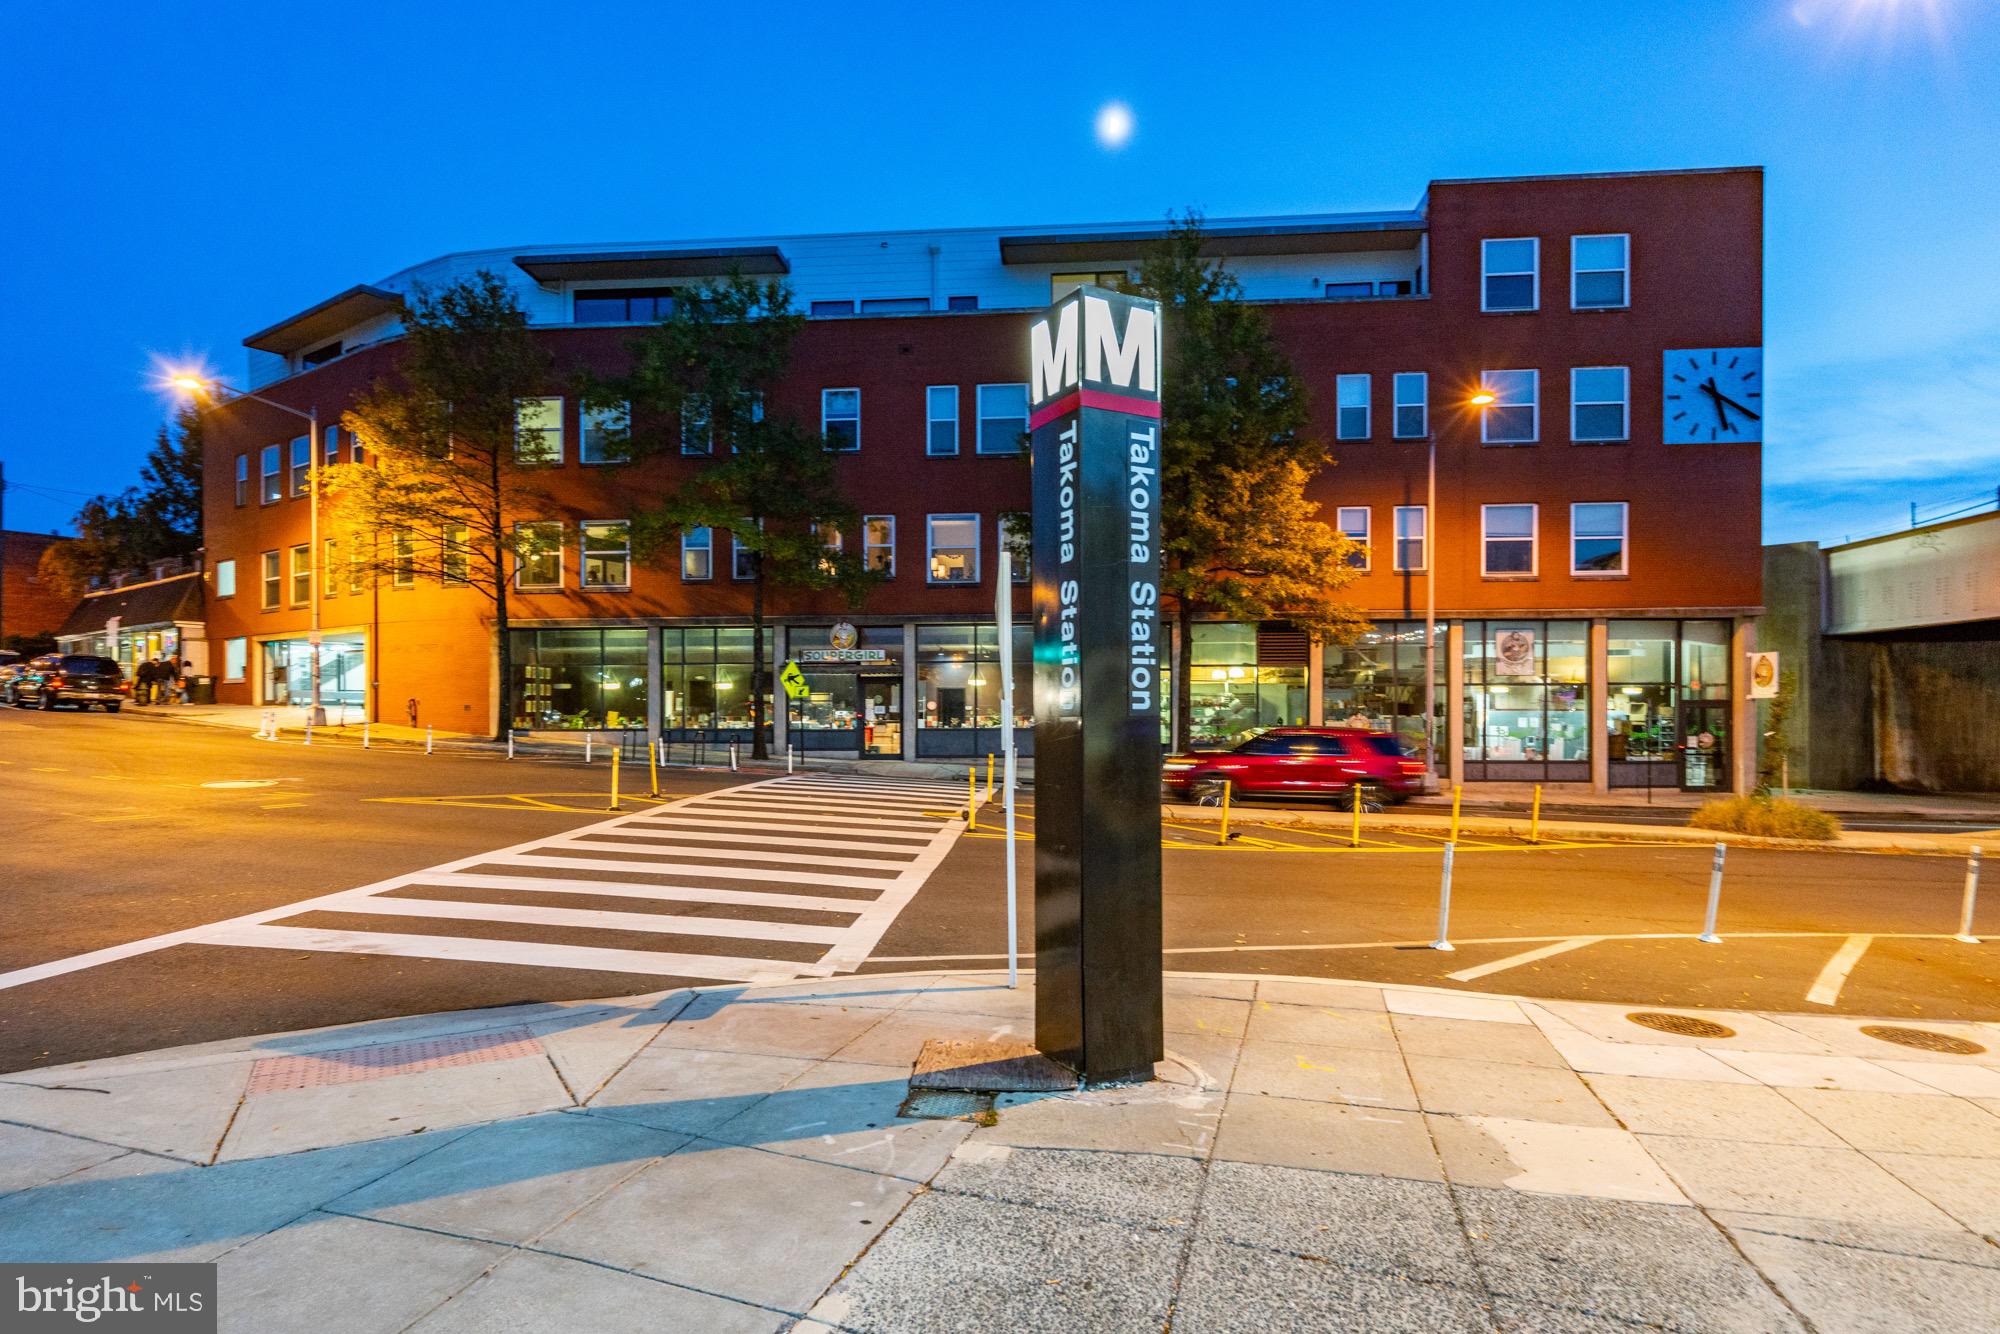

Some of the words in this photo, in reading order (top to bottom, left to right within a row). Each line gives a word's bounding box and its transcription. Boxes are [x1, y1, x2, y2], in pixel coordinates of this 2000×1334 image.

[1031, 300, 1078, 405] M
[1084, 295, 1155, 391] M
[1059, 420, 1078, 564] Takoma
[1130, 427, 1156, 563] Takoma
[805, 650, 883, 661] SOUPERGIRL
[1060, 580, 1079, 710] Station
[1130, 581, 1157, 710] Station
